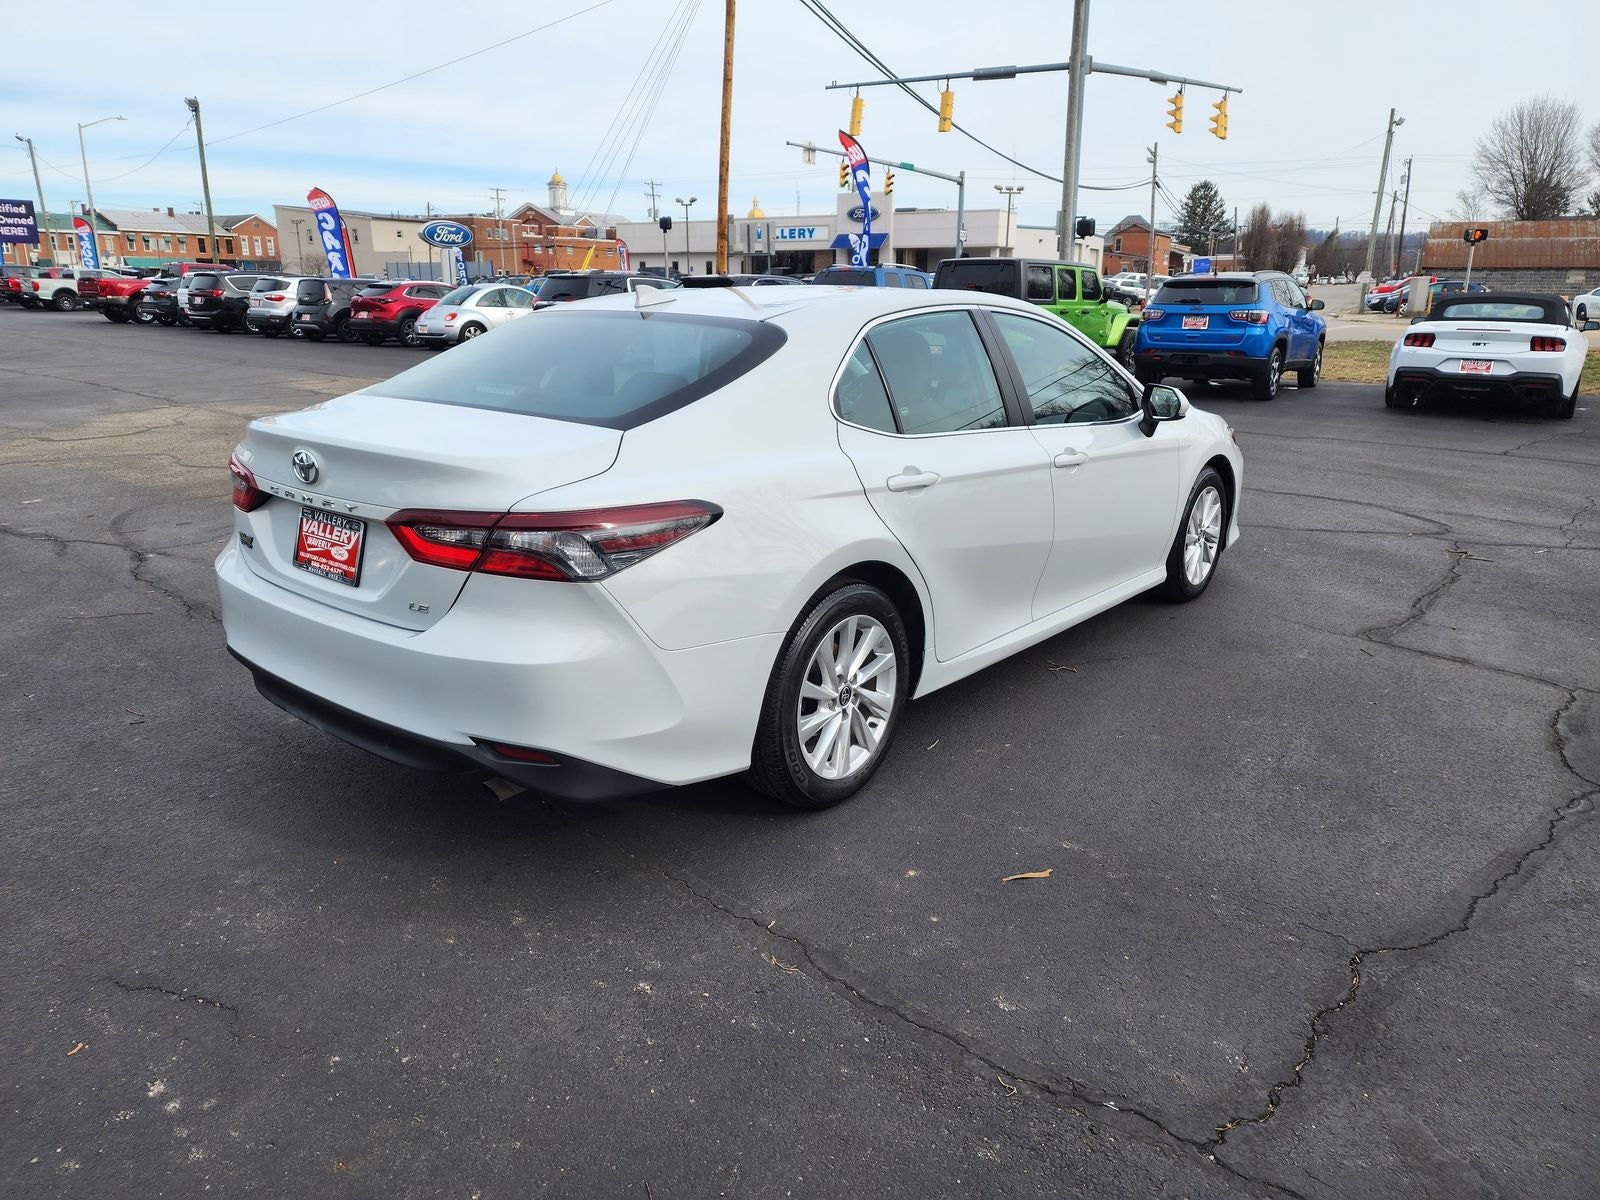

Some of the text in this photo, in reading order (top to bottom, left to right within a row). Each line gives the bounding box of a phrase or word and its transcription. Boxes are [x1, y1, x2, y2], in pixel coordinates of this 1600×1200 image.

[434, 225, 464, 242] Ford
[270, 486, 359, 513] CAMRY
[302, 517, 360, 543] VALLERY
[314, 511, 347, 528] VALLERY
